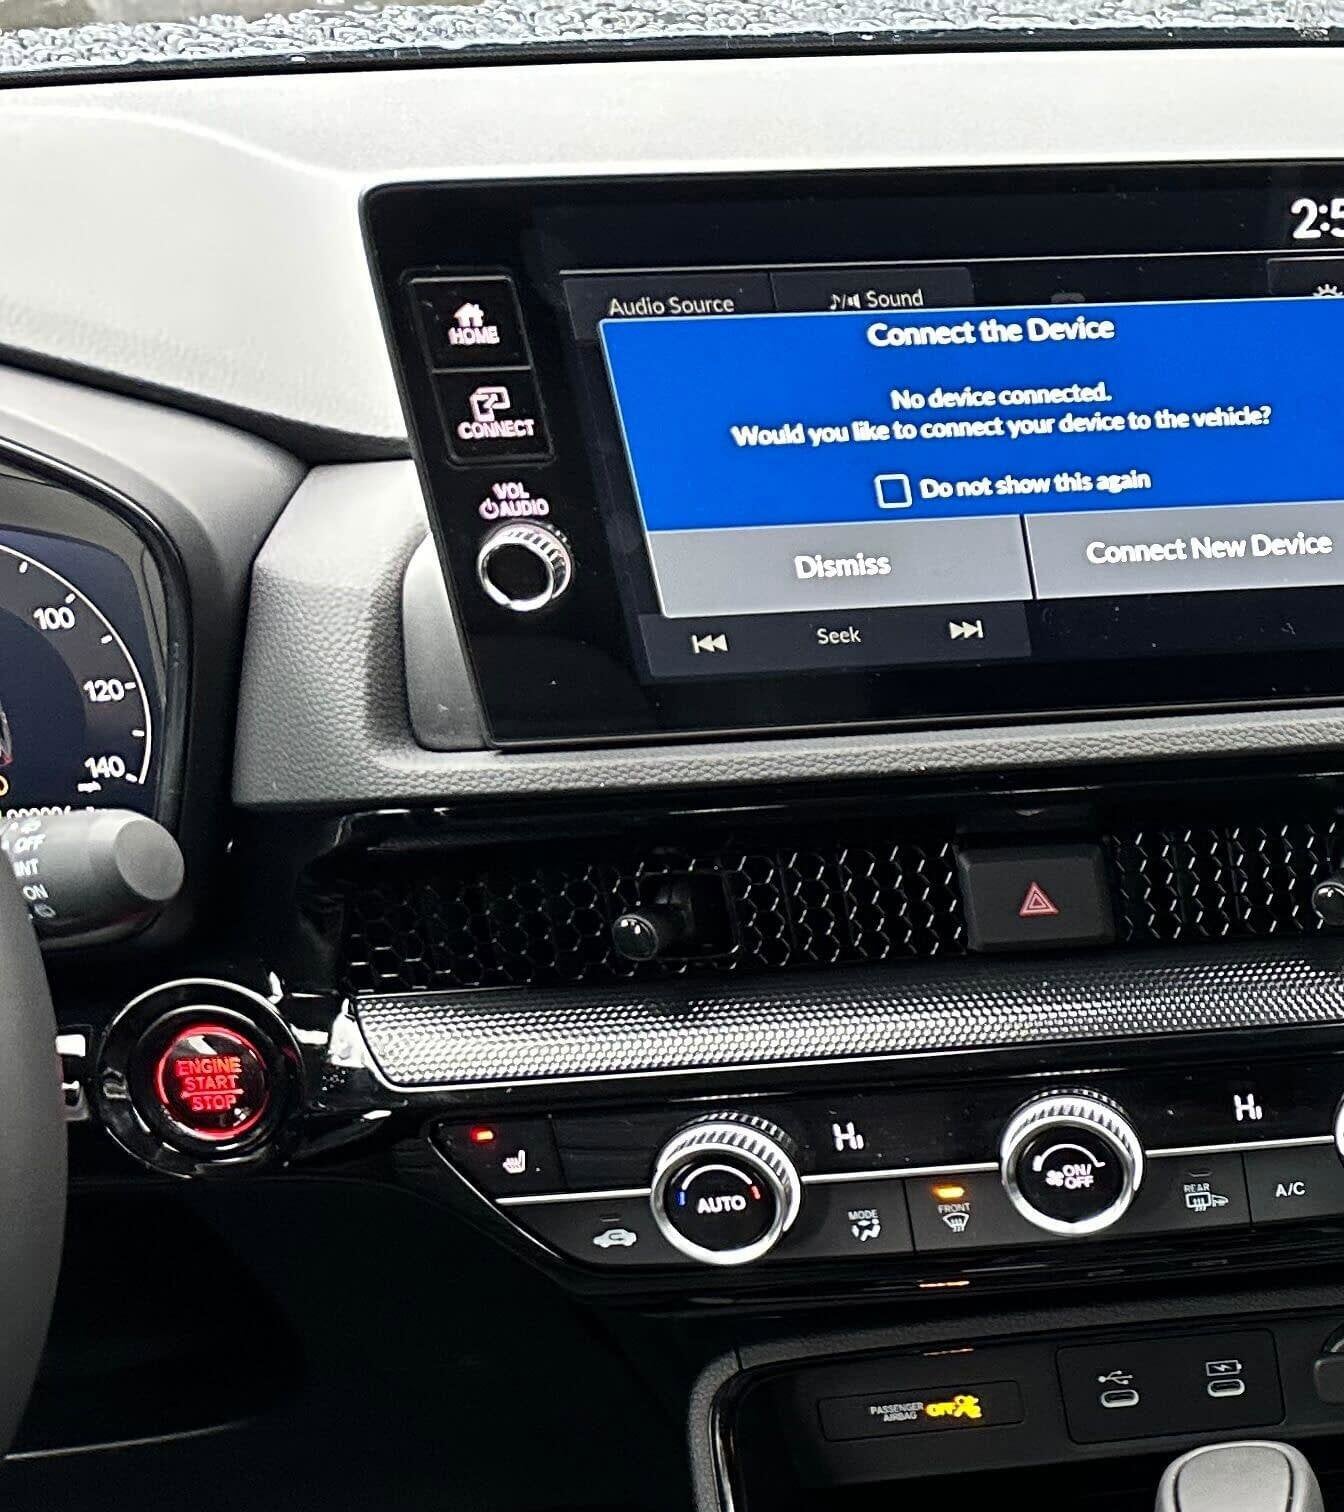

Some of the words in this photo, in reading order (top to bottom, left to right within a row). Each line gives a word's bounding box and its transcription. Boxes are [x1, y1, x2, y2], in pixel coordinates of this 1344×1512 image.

[609, 296, 665, 316] Audio
[670, 296, 734, 314] Source
[867, 289, 924, 308] Sound
[448, 326, 500, 345] HOME
[867, 321, 976, 347] Connect
[979, 319, 1023, 343] the
[1027, 316, 1115, 342] Device
[890, 389, 926, 410] No
[928, 386, 996, 408] device
[999, 382, 1112, 405] connected.
[457, 419, 535, 440] CONNECT
[730, 423, 805, 447] Would
[807, 426, 850, 447] you
[851, 420, 890, 441] like
[893, 420, 917, 439] to
[920, 417, 1004, 438] connect
[1006, 417, 1055, 439] your
[1059, 411, 1125, 433] device
[1128, 411, 1151, 430] to
[1154, 408, 1190, 429] the
[1191, 406, 1271, 427] vehicle?
[492, 482, 530, 499] VOL
[919, 478, 953, 499] Do
[956, 477, 994, 497] not
[996, 474, 1050, 495] show
[1053, 472, 1093, 493] this
[1096, 470, 1151, 493] again
[499, 498, 550, 517] AUDIO
[1086, 538, 1188, 565] Connect
[1190, 537, 1247, 560] New
[1250, 531, 1333, 557] Device
[794, 553, 892, 579] Dismiss
[33, 606, 76, 631] 100
[816, 626, 861, 645] Seek
[84, 679, 125, 702] 120
[84, 755, 126, 779] 140
[13, 833, 46, 854] OFF
[23, 883, 49, 901] ON
[176, 1056, 242, 1077] ENGINE
[184, 1074, 239, 1092] START
[192, 1095, 237, 1112] STOP
[1064, 1174, 1095, 1190] OFF
[1184, 1183, 1210, 1192] REAR
[1275, 1182, 1305, 1198] A/C
[697, 1195, 746, 1214] AUTO
[937, 1202, 971, 1213] FRONT
[848, 1209, 878, 1220] MODE
[870, 1402, 924, 1415] PASSENGER
[883, 1412, 917, 1422] AIRBAG
